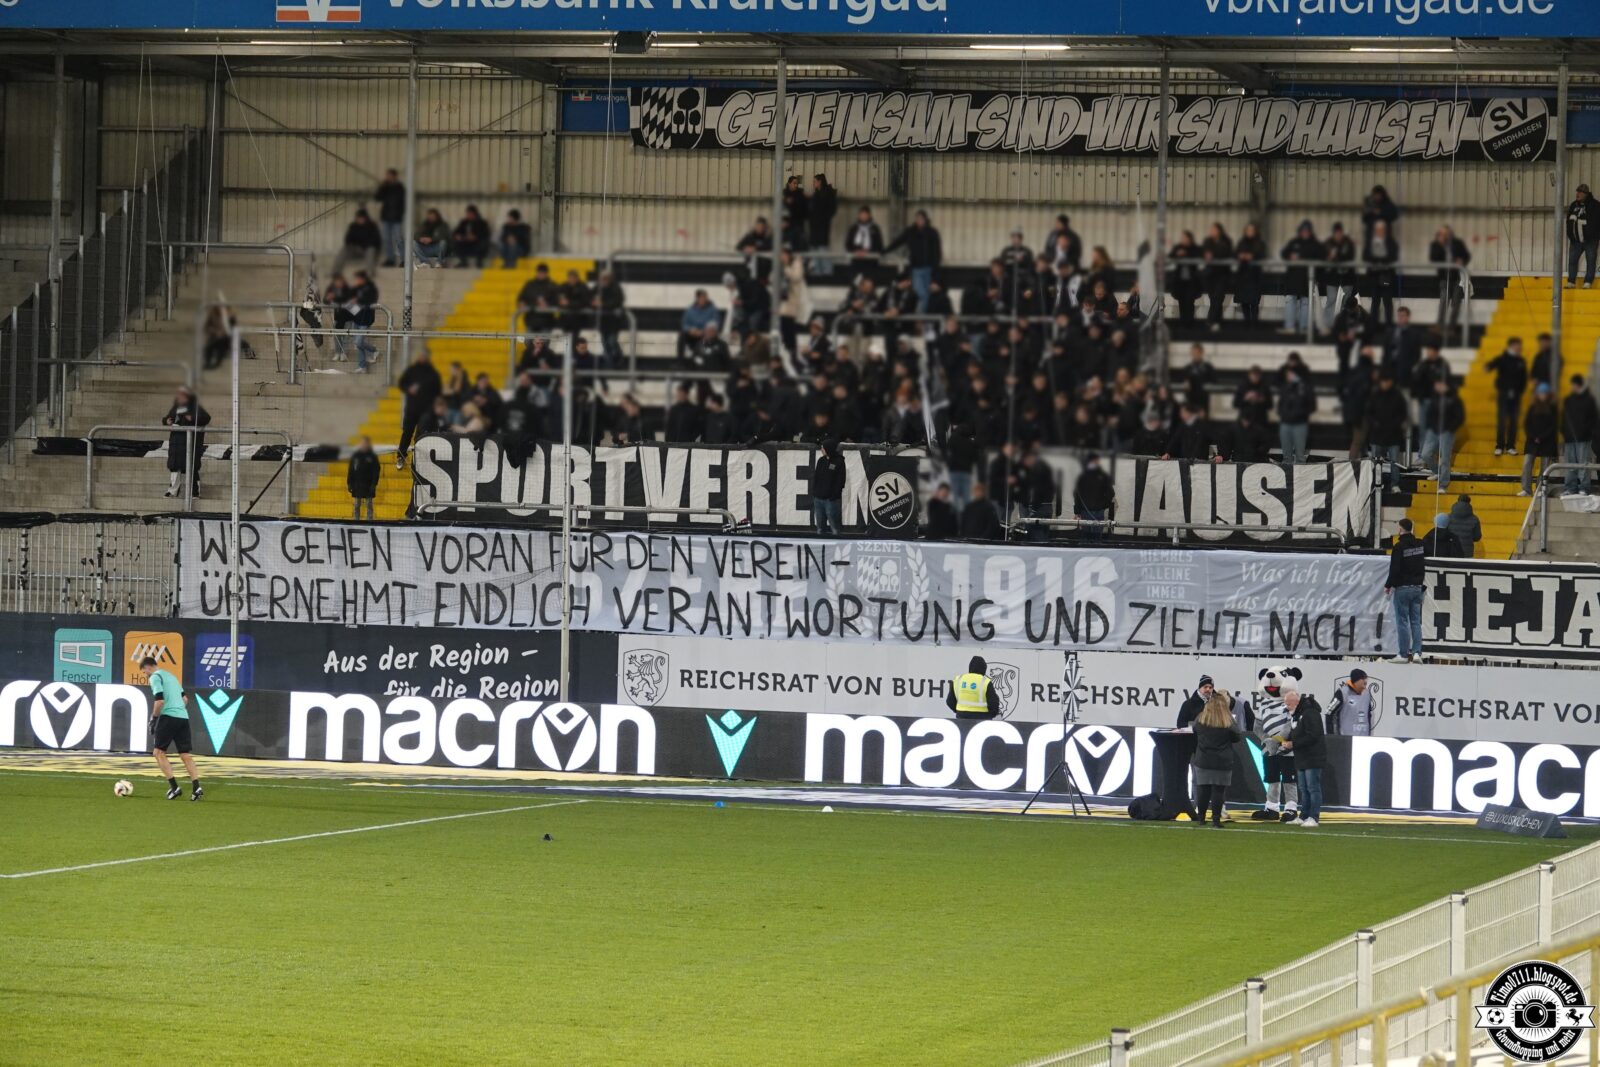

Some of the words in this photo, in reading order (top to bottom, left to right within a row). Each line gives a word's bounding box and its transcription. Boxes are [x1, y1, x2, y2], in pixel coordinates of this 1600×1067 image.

[717, 90, 972, 150] GEMEINSAM
[976, 93, 1083, 152] SIND
[1086, 94, 1177, 151] WIR
[1176, 96, 1470, 159] SANDHAUSEN
[1490, 99, 1528, 132] SV
[1491, 120, 1543, 151] SANDHAUSEN
[1511, 143, 1532, 159] 1916
[414, 435, 871, 527] SPORTVEREN
[875, 478, 900, 503] SV
[890, 511, 904, 522] 1916
[281, 525, 393, 572] GEHEN
[415, 532, 534, 574] VORAN
[549, 530, 615, 574] FÜR
[626, 534, 694, 575] DEN
[857, 541, 901, 553] SZENE
[1240, 561, 1285, 583] Was
[1290, 559, 1319, 584] ich
[1146, 586, 1186, 599] IMMER
[200, 570, 418, 625] ÜBERNEHMT
[434, 582, 591, 627] ENDLICH
[612, 584, 996, 642] VERANTWORTUNG
[1025, 597, 1110, 646] UND
[1126, 602, 1252, 649] ZIEHT
[1269, 611, 1356, 652] NACH
[1421, 571, 1600, 648] HEJA
[323, 650, 368, 674] Aus
[378, 645, 419, 671] der
[429, 642, 509, 675] Region
[62, 669, 102, 684] Fenster
[131, 674, 149, 684] Hol
[208, 675, 232, 688] Sola
[383, 679, 421, 697] für
[431, 676, 469, 699] die
[679, 668, 819, 694] REICHSRAT
[826, 674, 882, 697] VON
[1031, 683, 1175, 707] RECHSRAT
[1395, 696, 1546, 722] REICHSRAT
[288, 691, 656, 775] macron
